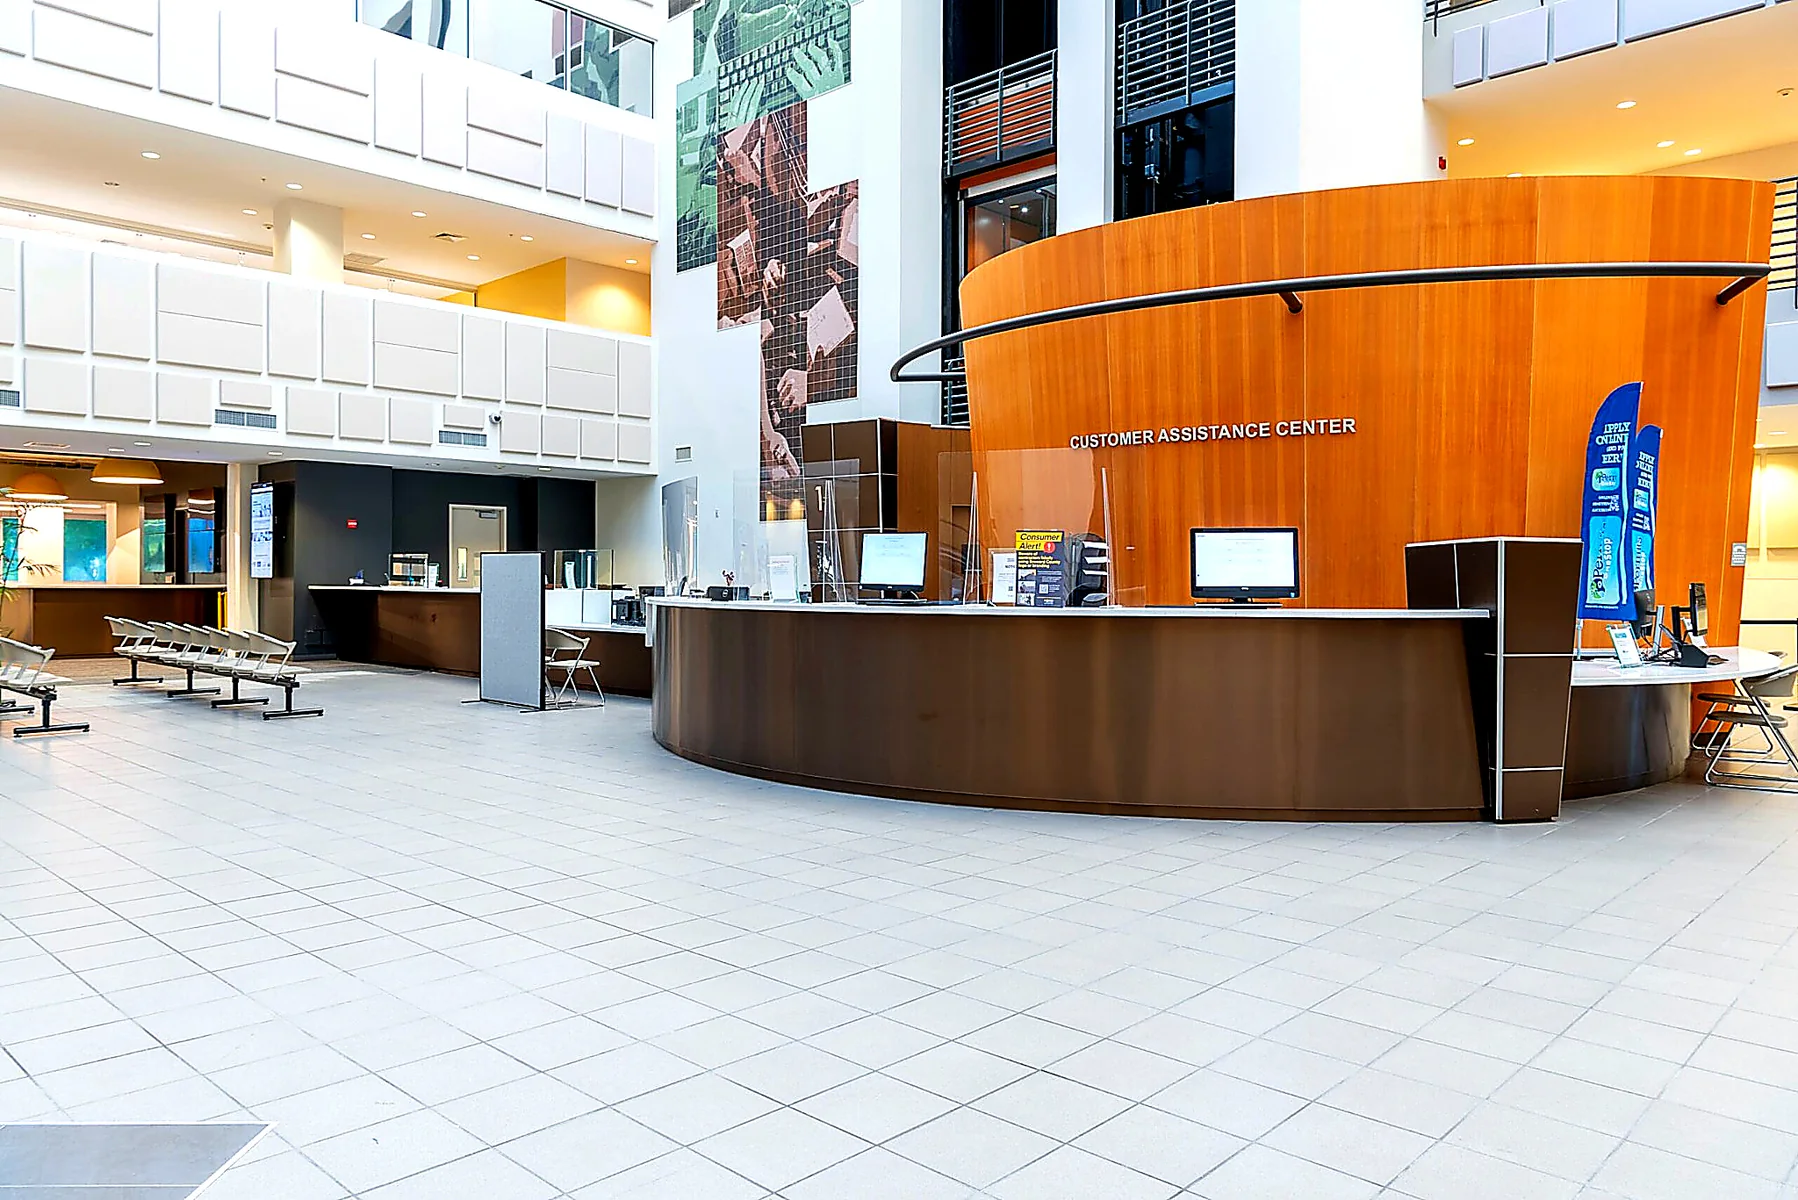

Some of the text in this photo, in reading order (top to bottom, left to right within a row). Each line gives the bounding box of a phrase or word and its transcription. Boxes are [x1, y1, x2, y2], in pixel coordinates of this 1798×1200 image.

[1070, 418, 1357, 449] CUSTOMER ASSISTANCE CENTER
[814, 485, 823, 511] 1
[1020, 533, 1060, 541] Consumer
[1019, 542, 1042, 550] Alert!
